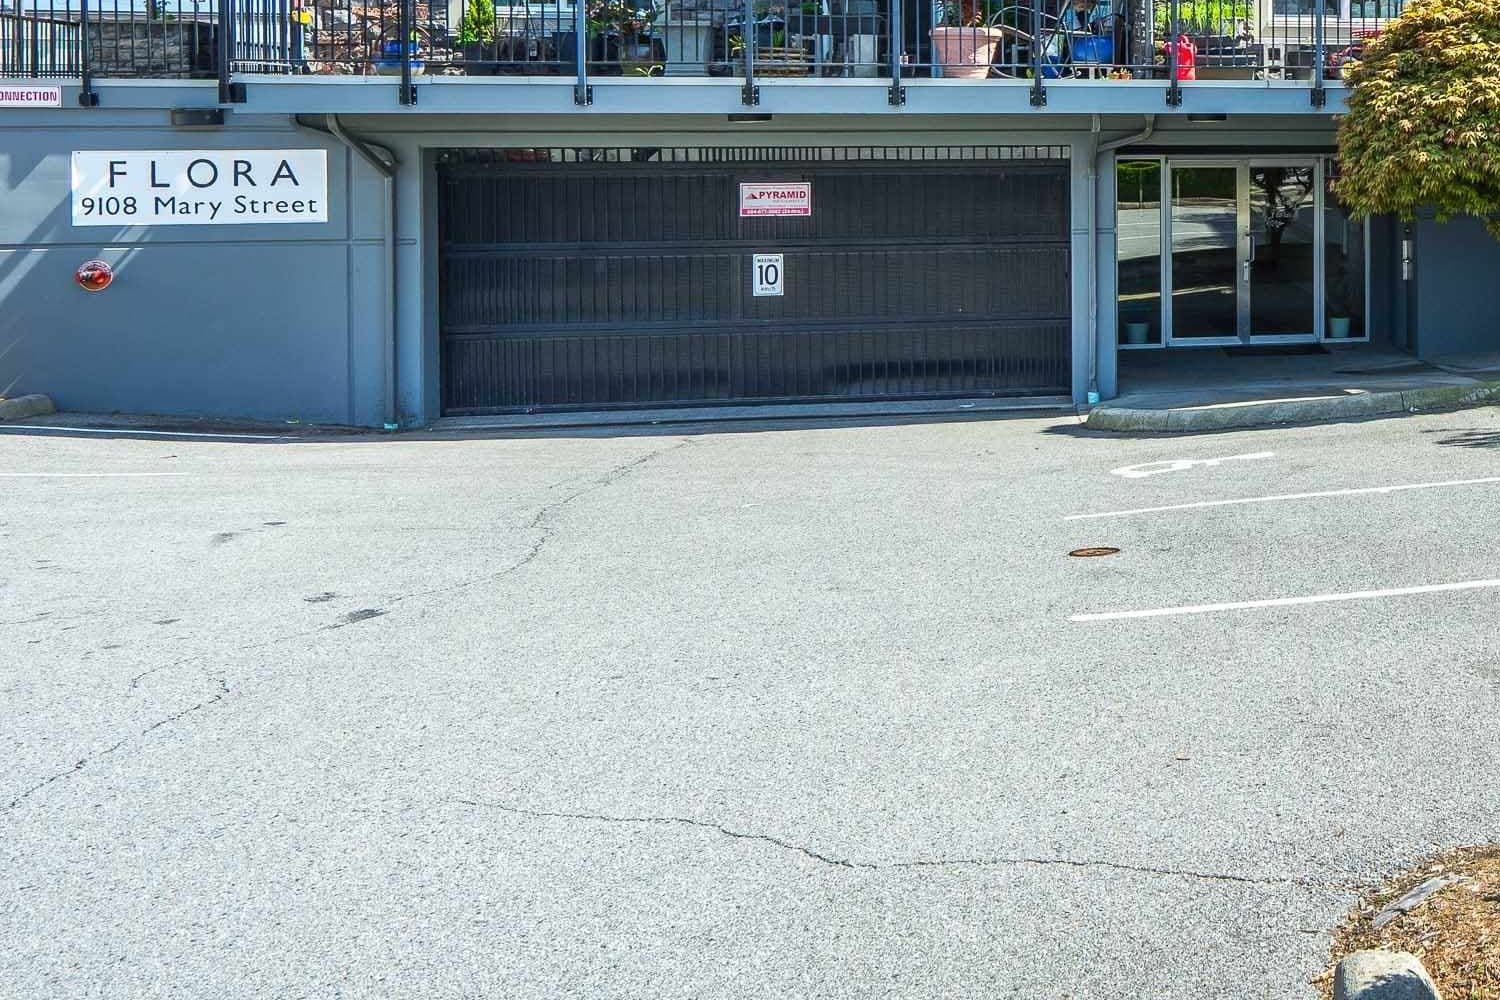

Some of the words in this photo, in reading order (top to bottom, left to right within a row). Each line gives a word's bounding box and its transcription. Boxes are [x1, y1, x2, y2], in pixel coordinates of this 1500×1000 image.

[109, 159, 300, 188] FLORA
[759, 191, 807, 199] PYRAMID
[81, 196, 138, 216] 9108
[154, 196, 223, 220] Mary
[234, 195, 319, 214] Street
[757, 264, 779, 285] 10
